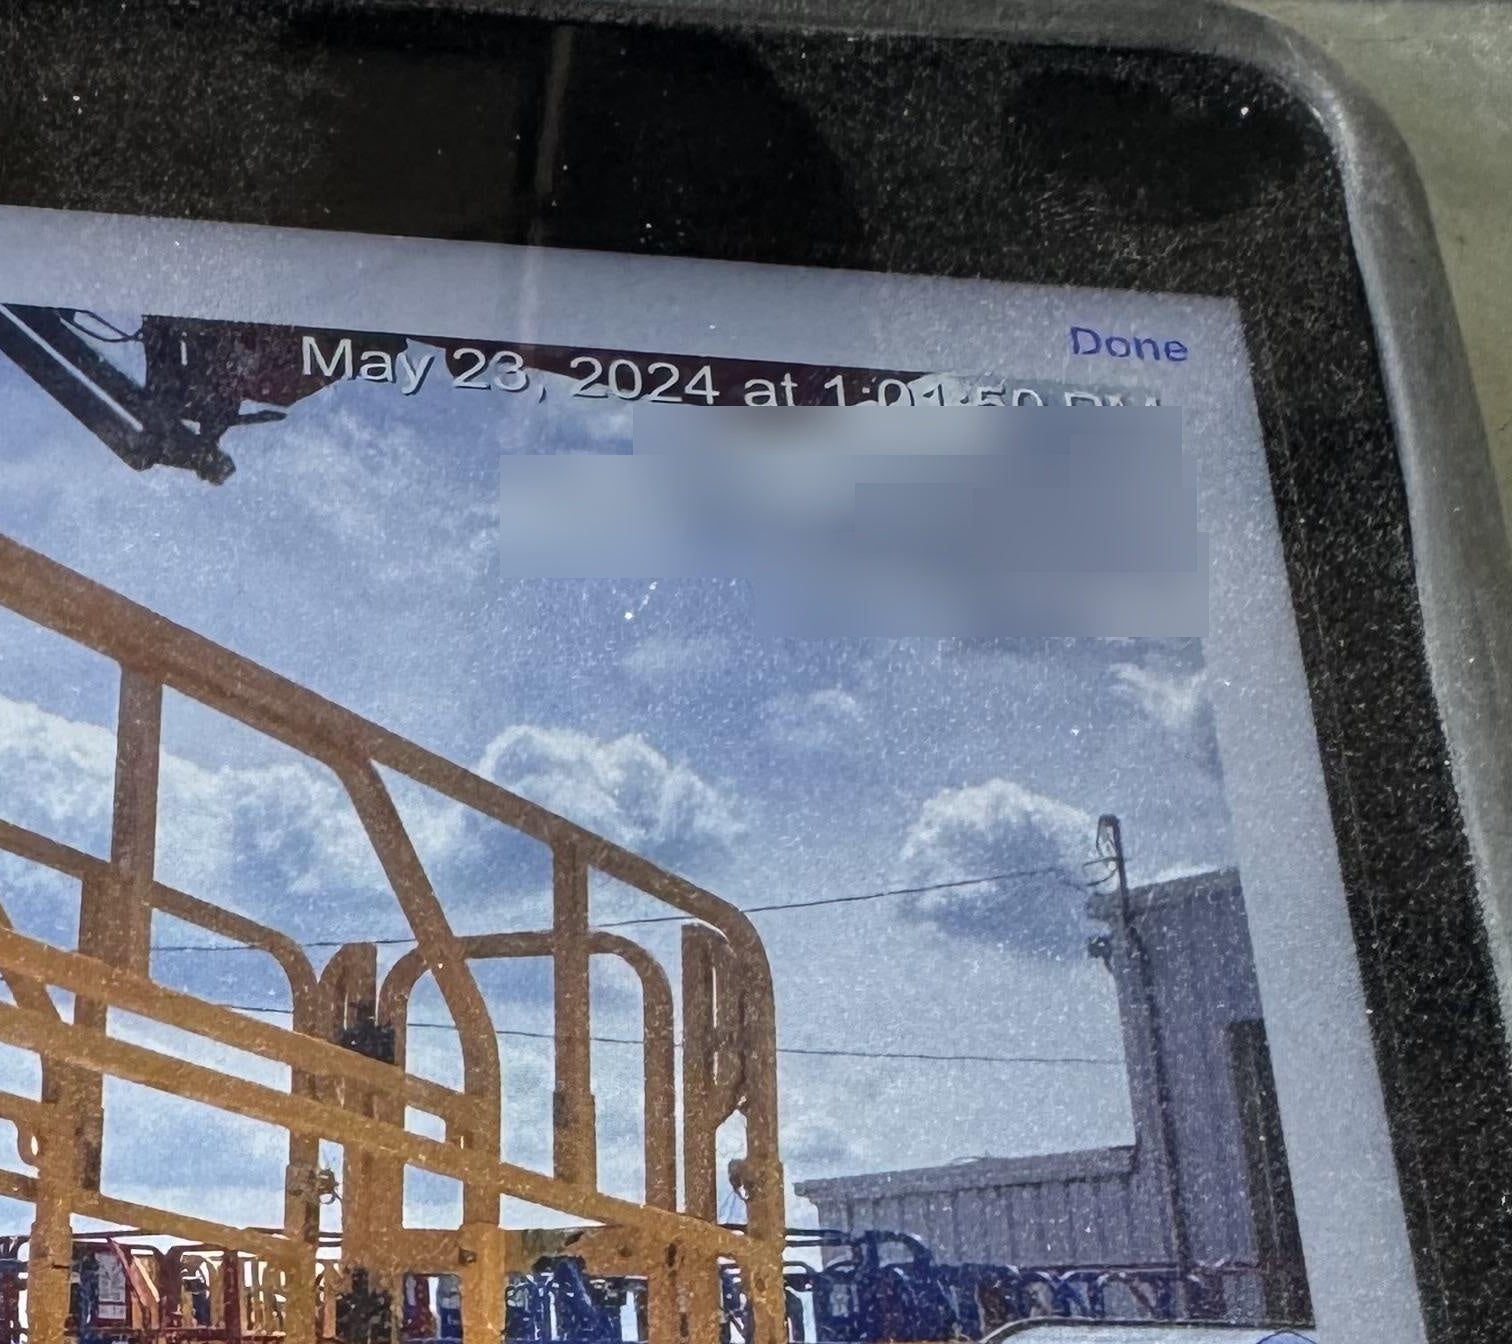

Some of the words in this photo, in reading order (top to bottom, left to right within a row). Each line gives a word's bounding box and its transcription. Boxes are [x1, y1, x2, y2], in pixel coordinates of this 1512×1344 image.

[301, 335, 433, 396] May
[452, 347, 546, 403] 23,
[569, 356, 720, 405] 2024
[744, 372, 798, 406] at
[1070, 325, 1189, 363] Done
